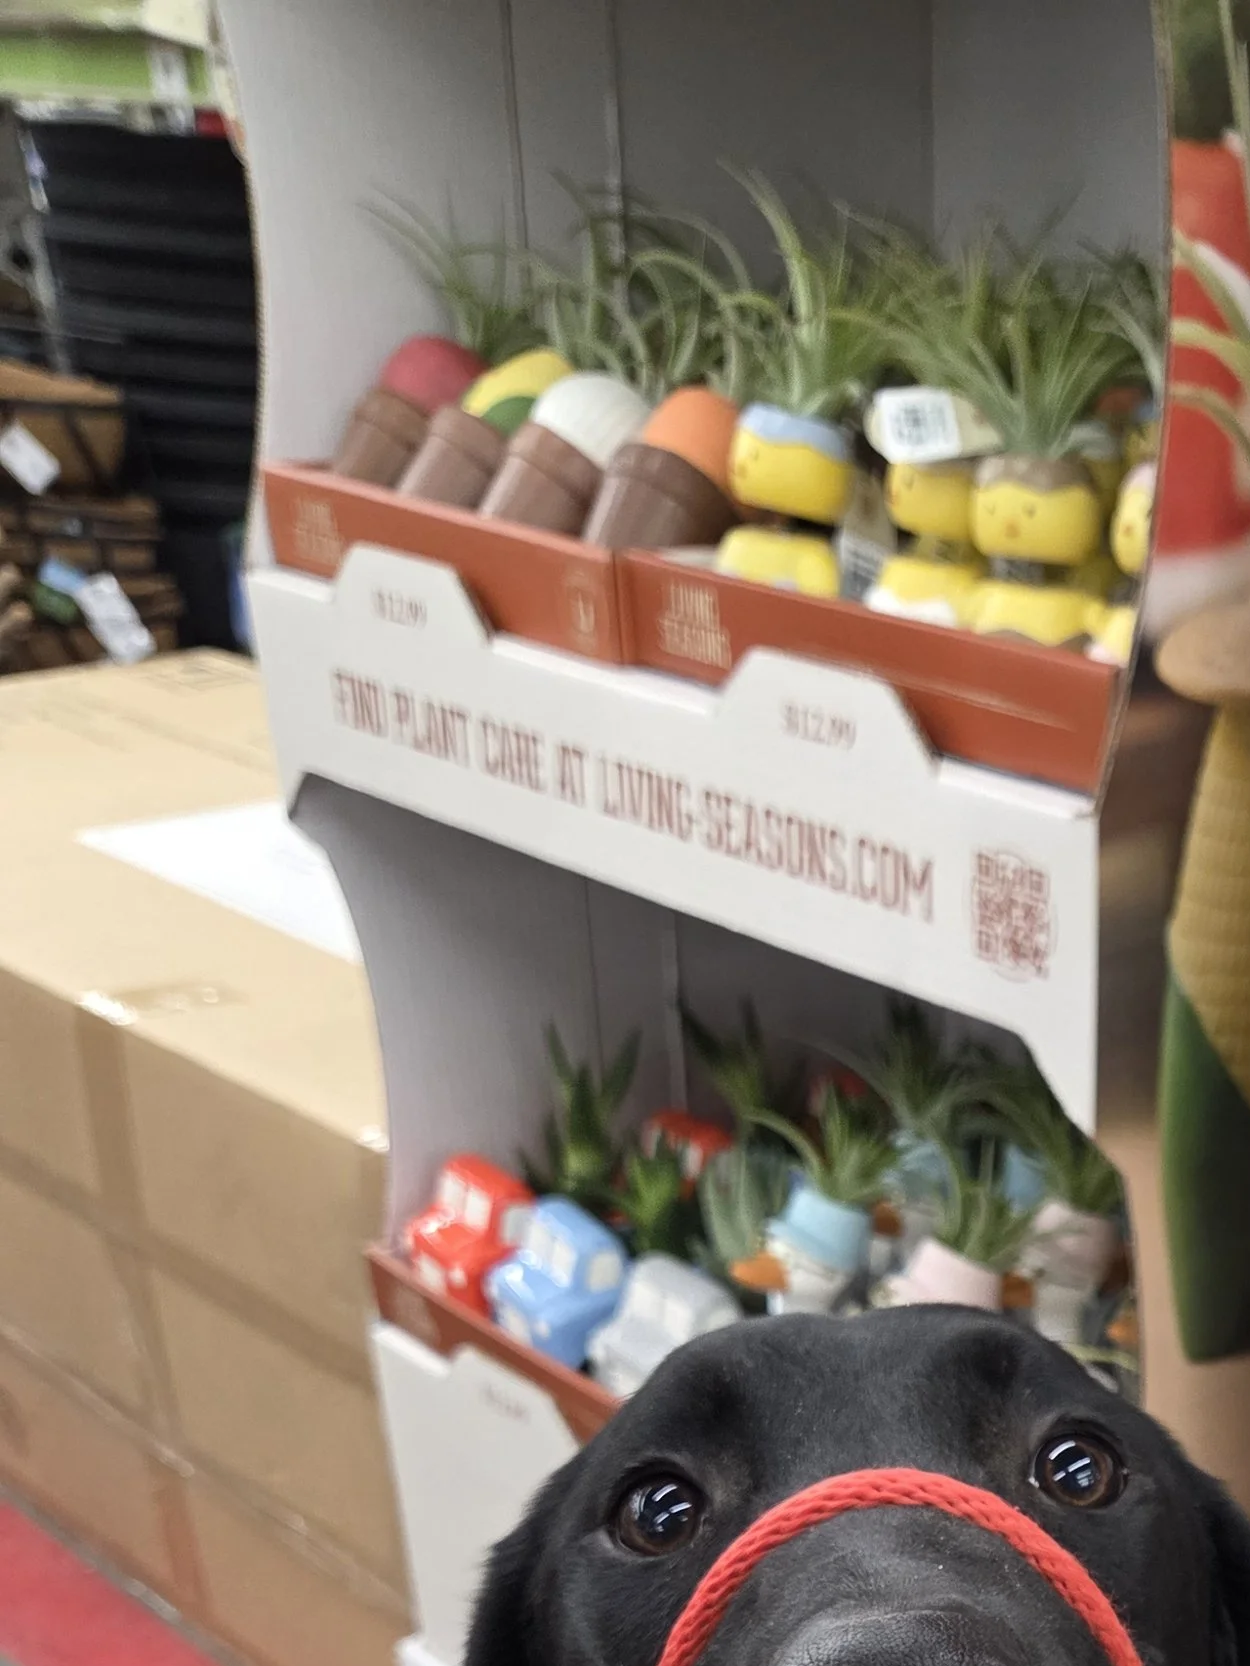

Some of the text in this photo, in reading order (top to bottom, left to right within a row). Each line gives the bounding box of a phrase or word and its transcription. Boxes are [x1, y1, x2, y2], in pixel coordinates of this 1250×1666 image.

[332, 668, 387, 738] FIND
[392, 685, 471, 768] PLANT
[477, 712, 547, 794] CARE
[553, 742, 586, 808] AT
